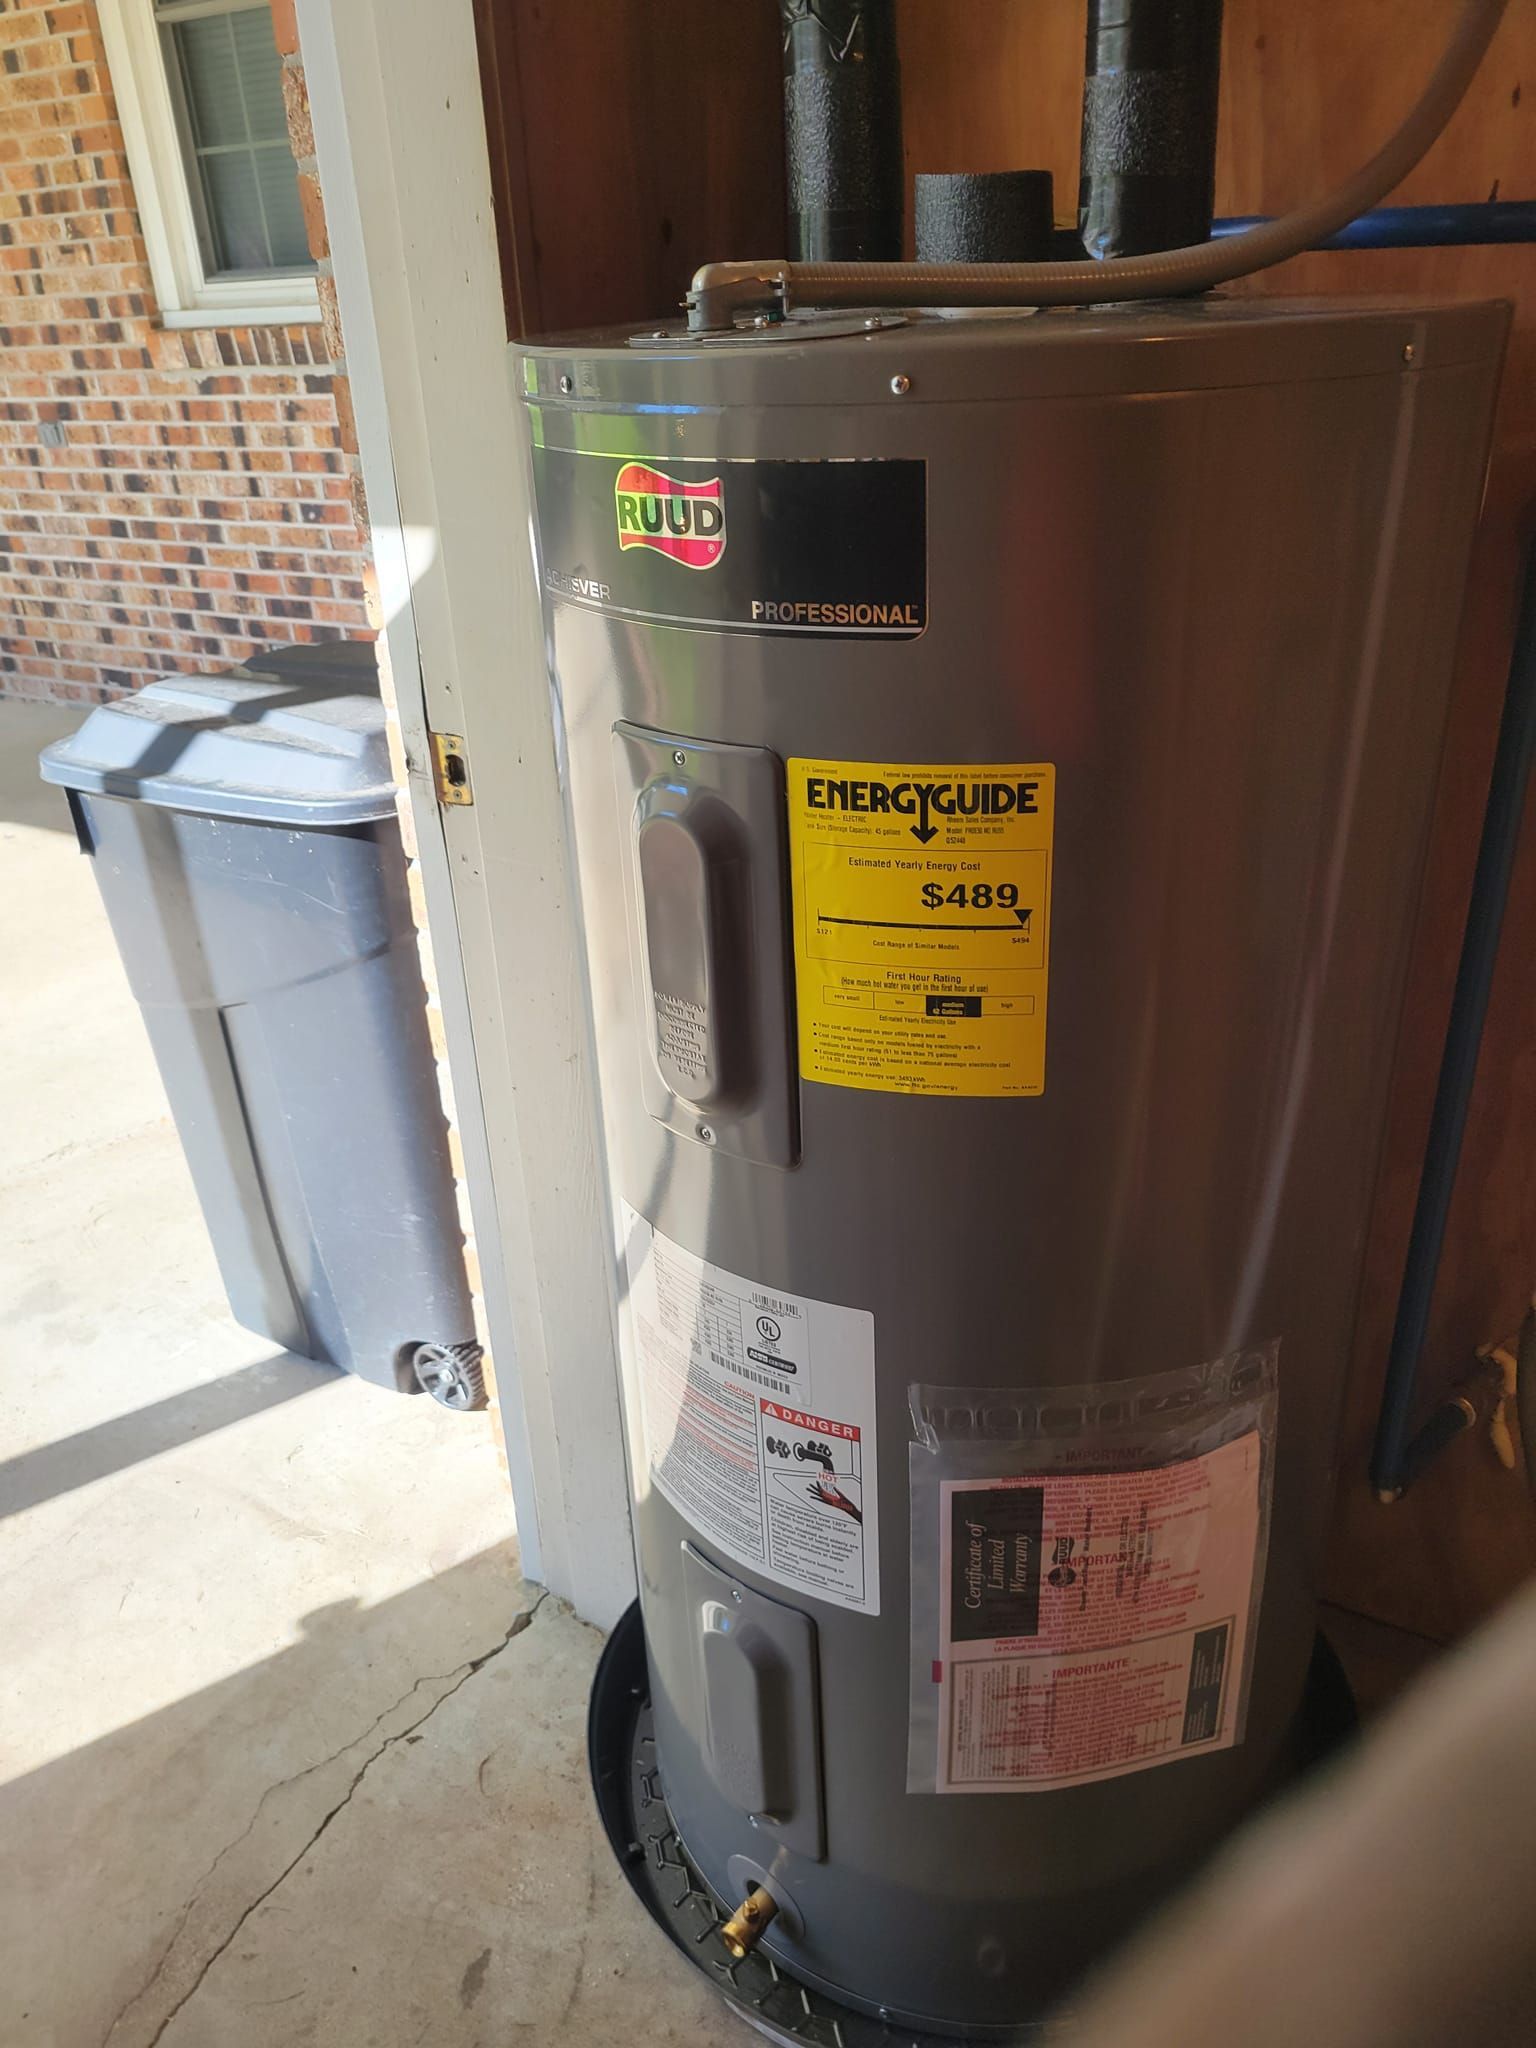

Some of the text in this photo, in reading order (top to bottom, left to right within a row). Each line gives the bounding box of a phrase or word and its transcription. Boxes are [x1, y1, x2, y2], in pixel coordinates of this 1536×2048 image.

[617, 494, 724, 537] RUUD
[751, 600, 919, 625] PROFESSIONAL
[806, 777, 1039, 816] ENERGYGUIDE
[842, 815, 867, 823] ELECTRIC
[848, 856, 981, 872] Estimated Yearly Energy Cost
[920, 881, 1019, 911] $489
[816, 928, 832, 936] $121
[887, 940, 906, 950] Range
[840, 976, 855, 986] (How
[856, 978, 872, 988] much
[873, 980, 882, 988] hot
[884, 982, 899, 990] water
[900, 984, 910, 992] you
[912, 983, 922, 992] get
[922, 984, 929, 992] in
[930, 984, 940, 992] the
[941, 984, 953, 992] first
[954, 984, 968, 992] hour
[969, 984, 976, 992] of
[886, 970, 962, 984] First Hour Rating
[879, 1014, 902, 1023] Estimated
[904, 1016, 920, 1024] Yearly
[921, 1018, 946, 1026] Electricity
[761, 1319, 776, 1338] UL
[723, 1380, 755, 1399] CAUTION
[782, 1408, 854, 1438] DANGER
[1065, 1447, 1144, 1463] IMPORTANT
[818, 1472, 838, 1483] HOT
[964, 1520, 988, 1609] Certificate of
[987, 1538, 1006, 1590] Limited
[1009, 1532, 1032, 1593] Warranty
[1052, 1657, 1130, 1679] IMPORTANTE
